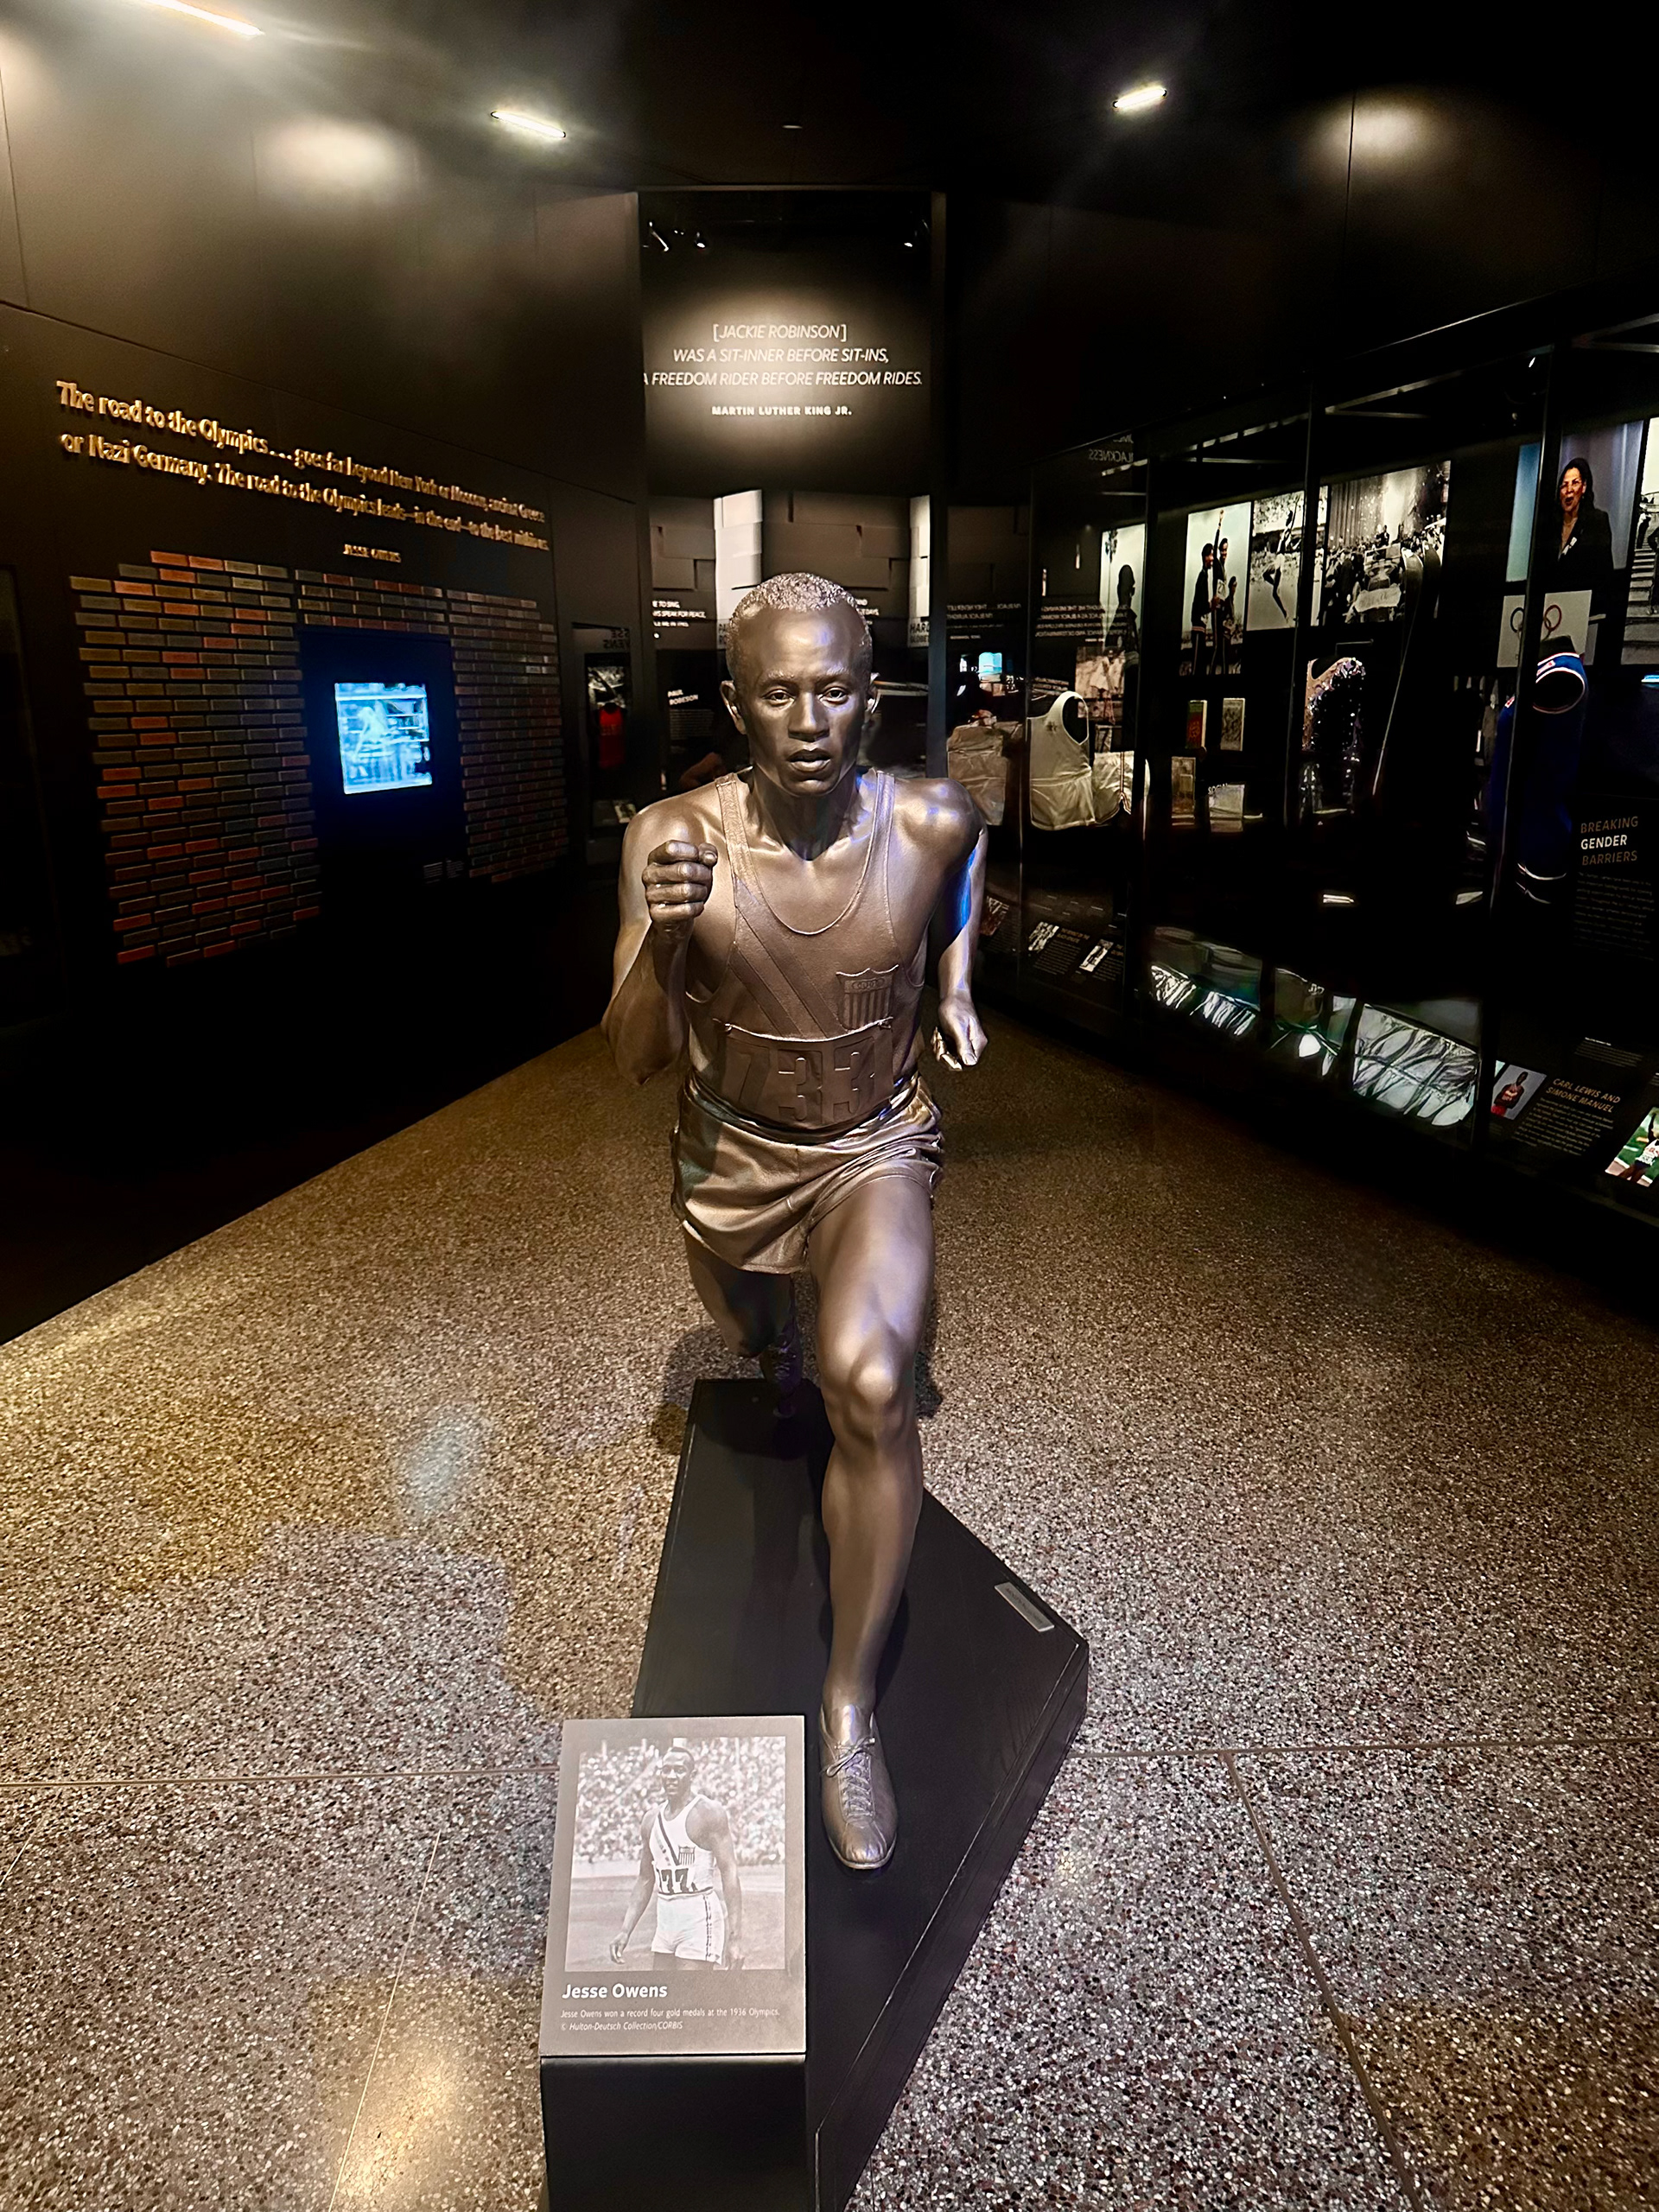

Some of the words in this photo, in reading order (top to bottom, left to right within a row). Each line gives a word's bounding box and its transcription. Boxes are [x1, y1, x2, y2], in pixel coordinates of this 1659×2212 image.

[673, 348, 704, 362] WAS
[706, 348, 716, 362] A
[720, 348, 784, 362] SIT-INNER
[786, 348, 838, 362] BEFORE
[841, 348, 889, 364] SIT-INS,
[652, 372, 716, 385] FREEDOM
[719, 372, 759, 385] RIDER
[761, 372, 813, 385] BEFORE
[815, 372, 880, 385] FREEDOM
[883, 372, 922, 385] RIDES.
[712, 406, 754, 416] MARTIN
[758, 406, 800, 416] LUTHER
[804, 406, 831, 416] KING
[835, 406, 852, 416] JR.
[56, 380, 94, 412] The
[99, 396, 142, 423] road
[145, 405, 165, 429] to
[168, 410, 197, 437] the
[346, 456, 388, 484] beyond
[60, 434, 84, 454] or
[89, 434, 130, 464] Nazi
[132, 444, 213, 486] Germany.
[214, 462, 245, 487] The
[246, 474, 280, 494] road
[282, 480, 297, 499] to
[299, 482, 321, 504] the
[323, 487, 378, 517] Olympics
[1580, 816, 1639, 834] BREAKING
[1580, 834, 1628, 850] GENDER
[1582, 850, 1637, 866] BARRIERS
[1553, 1077, 1575, 1090] CARL
[1575, 1084, 1601, 1098] LEWIS
[1600, 1092, 1621, 1104] AND
[1546, 1086, 1579, 1103] SIMONE
[1578, 1096, 1615, 1114] MANUEL
[562, 1983, 607, 1999] Jesse
[612, 1982, 668, 1999] Owens
[561, 2009, 578, 2018] Jesse
[580, 2009, 602, 2018] Owens
[626, 2008, 648, 2018] record
[650, 2007, 664, 2017] four
[665, 2007, 681, 2019] gold
[683, 2007, 705, 2017] medals
[716, 2007, 728, 2017] the
[730, 2007, 747, 2017] 1936
[748, 2006, 780, 2018] Olympics.
[569, 2021, 621, 2031] Hulton-Deutsch
[623, 2020, 683, 2031] Collection/CORBIS
